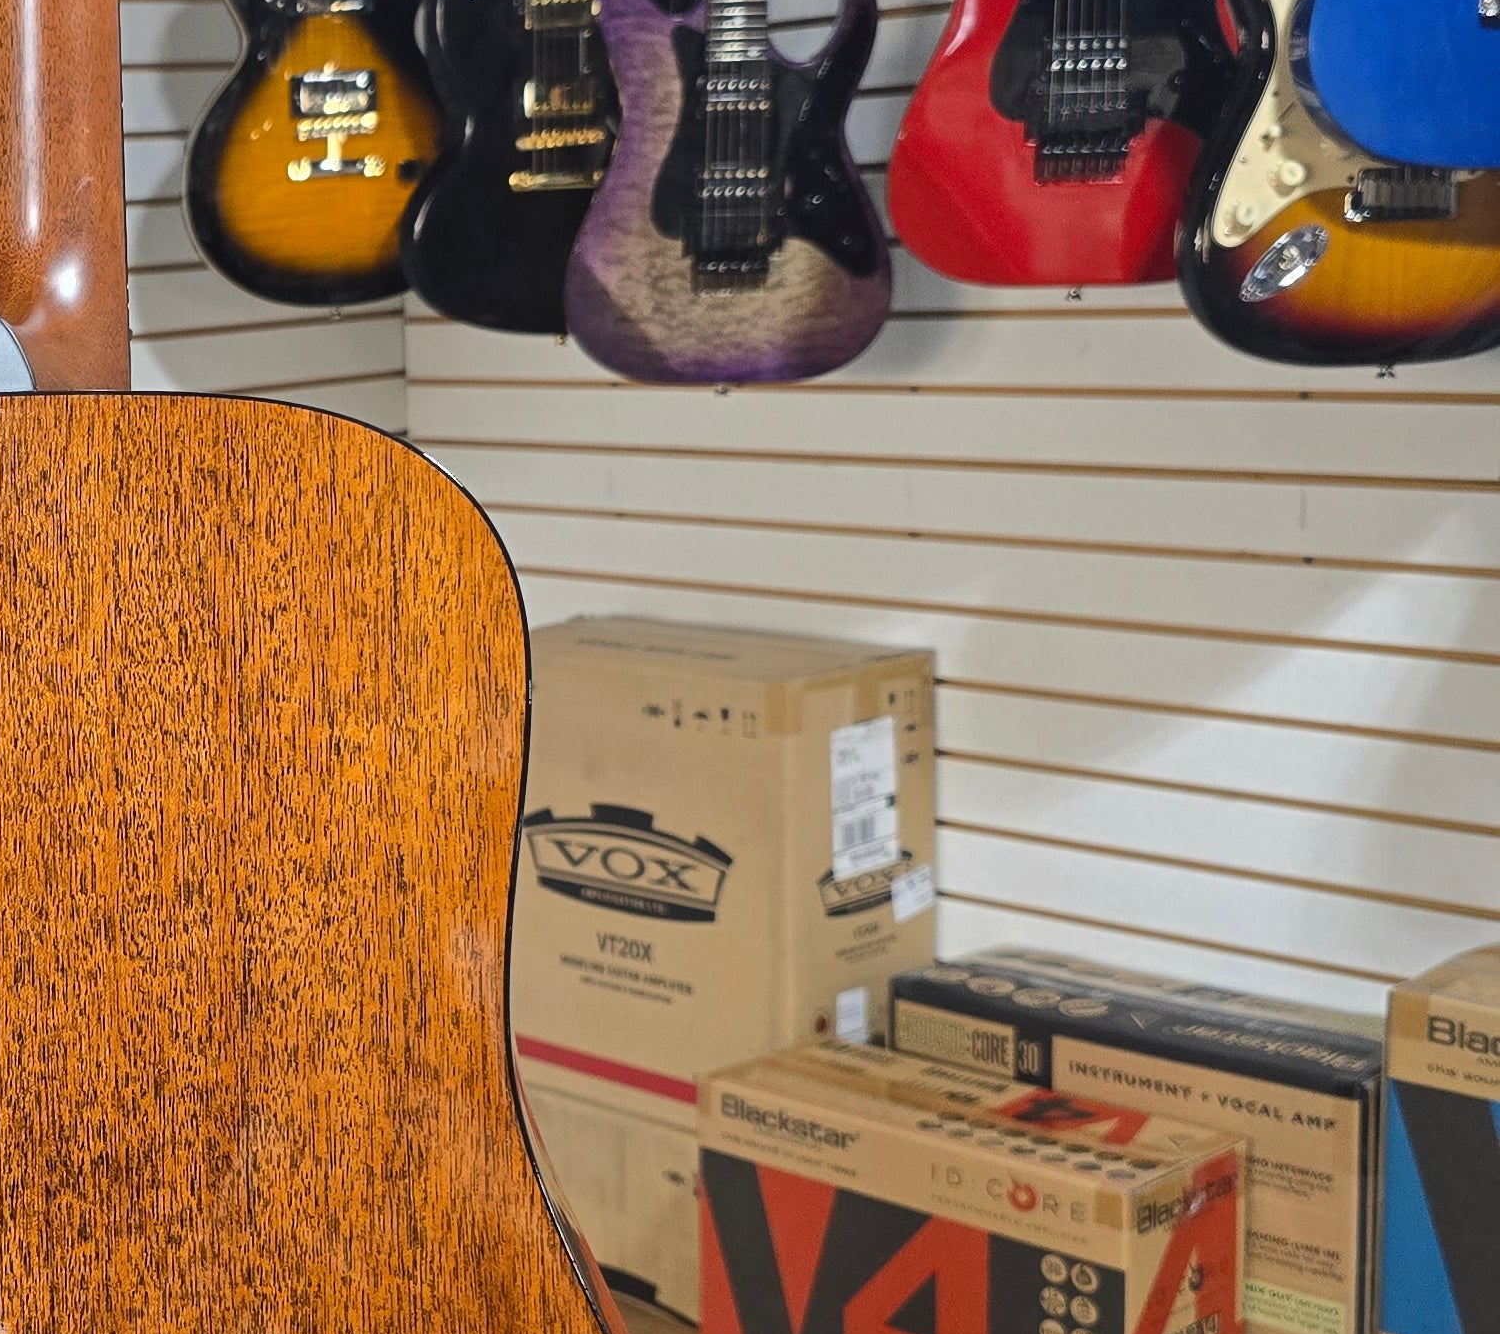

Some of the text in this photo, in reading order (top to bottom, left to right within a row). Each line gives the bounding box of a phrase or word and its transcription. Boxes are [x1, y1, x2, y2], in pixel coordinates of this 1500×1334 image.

[548, 837, 700, 894] VOX
[596, 932, 654, 965] VT20X
[1017, 1040, 1041, 1074] 30
[721, 1092, 856, 1150] Blackstar
[1068, 1060, 1194, 1098] INSTRUMENT
[1215, 1094, 1284, 1123] VOCAL
[1291, 1112, 1338, 1133] AMP
